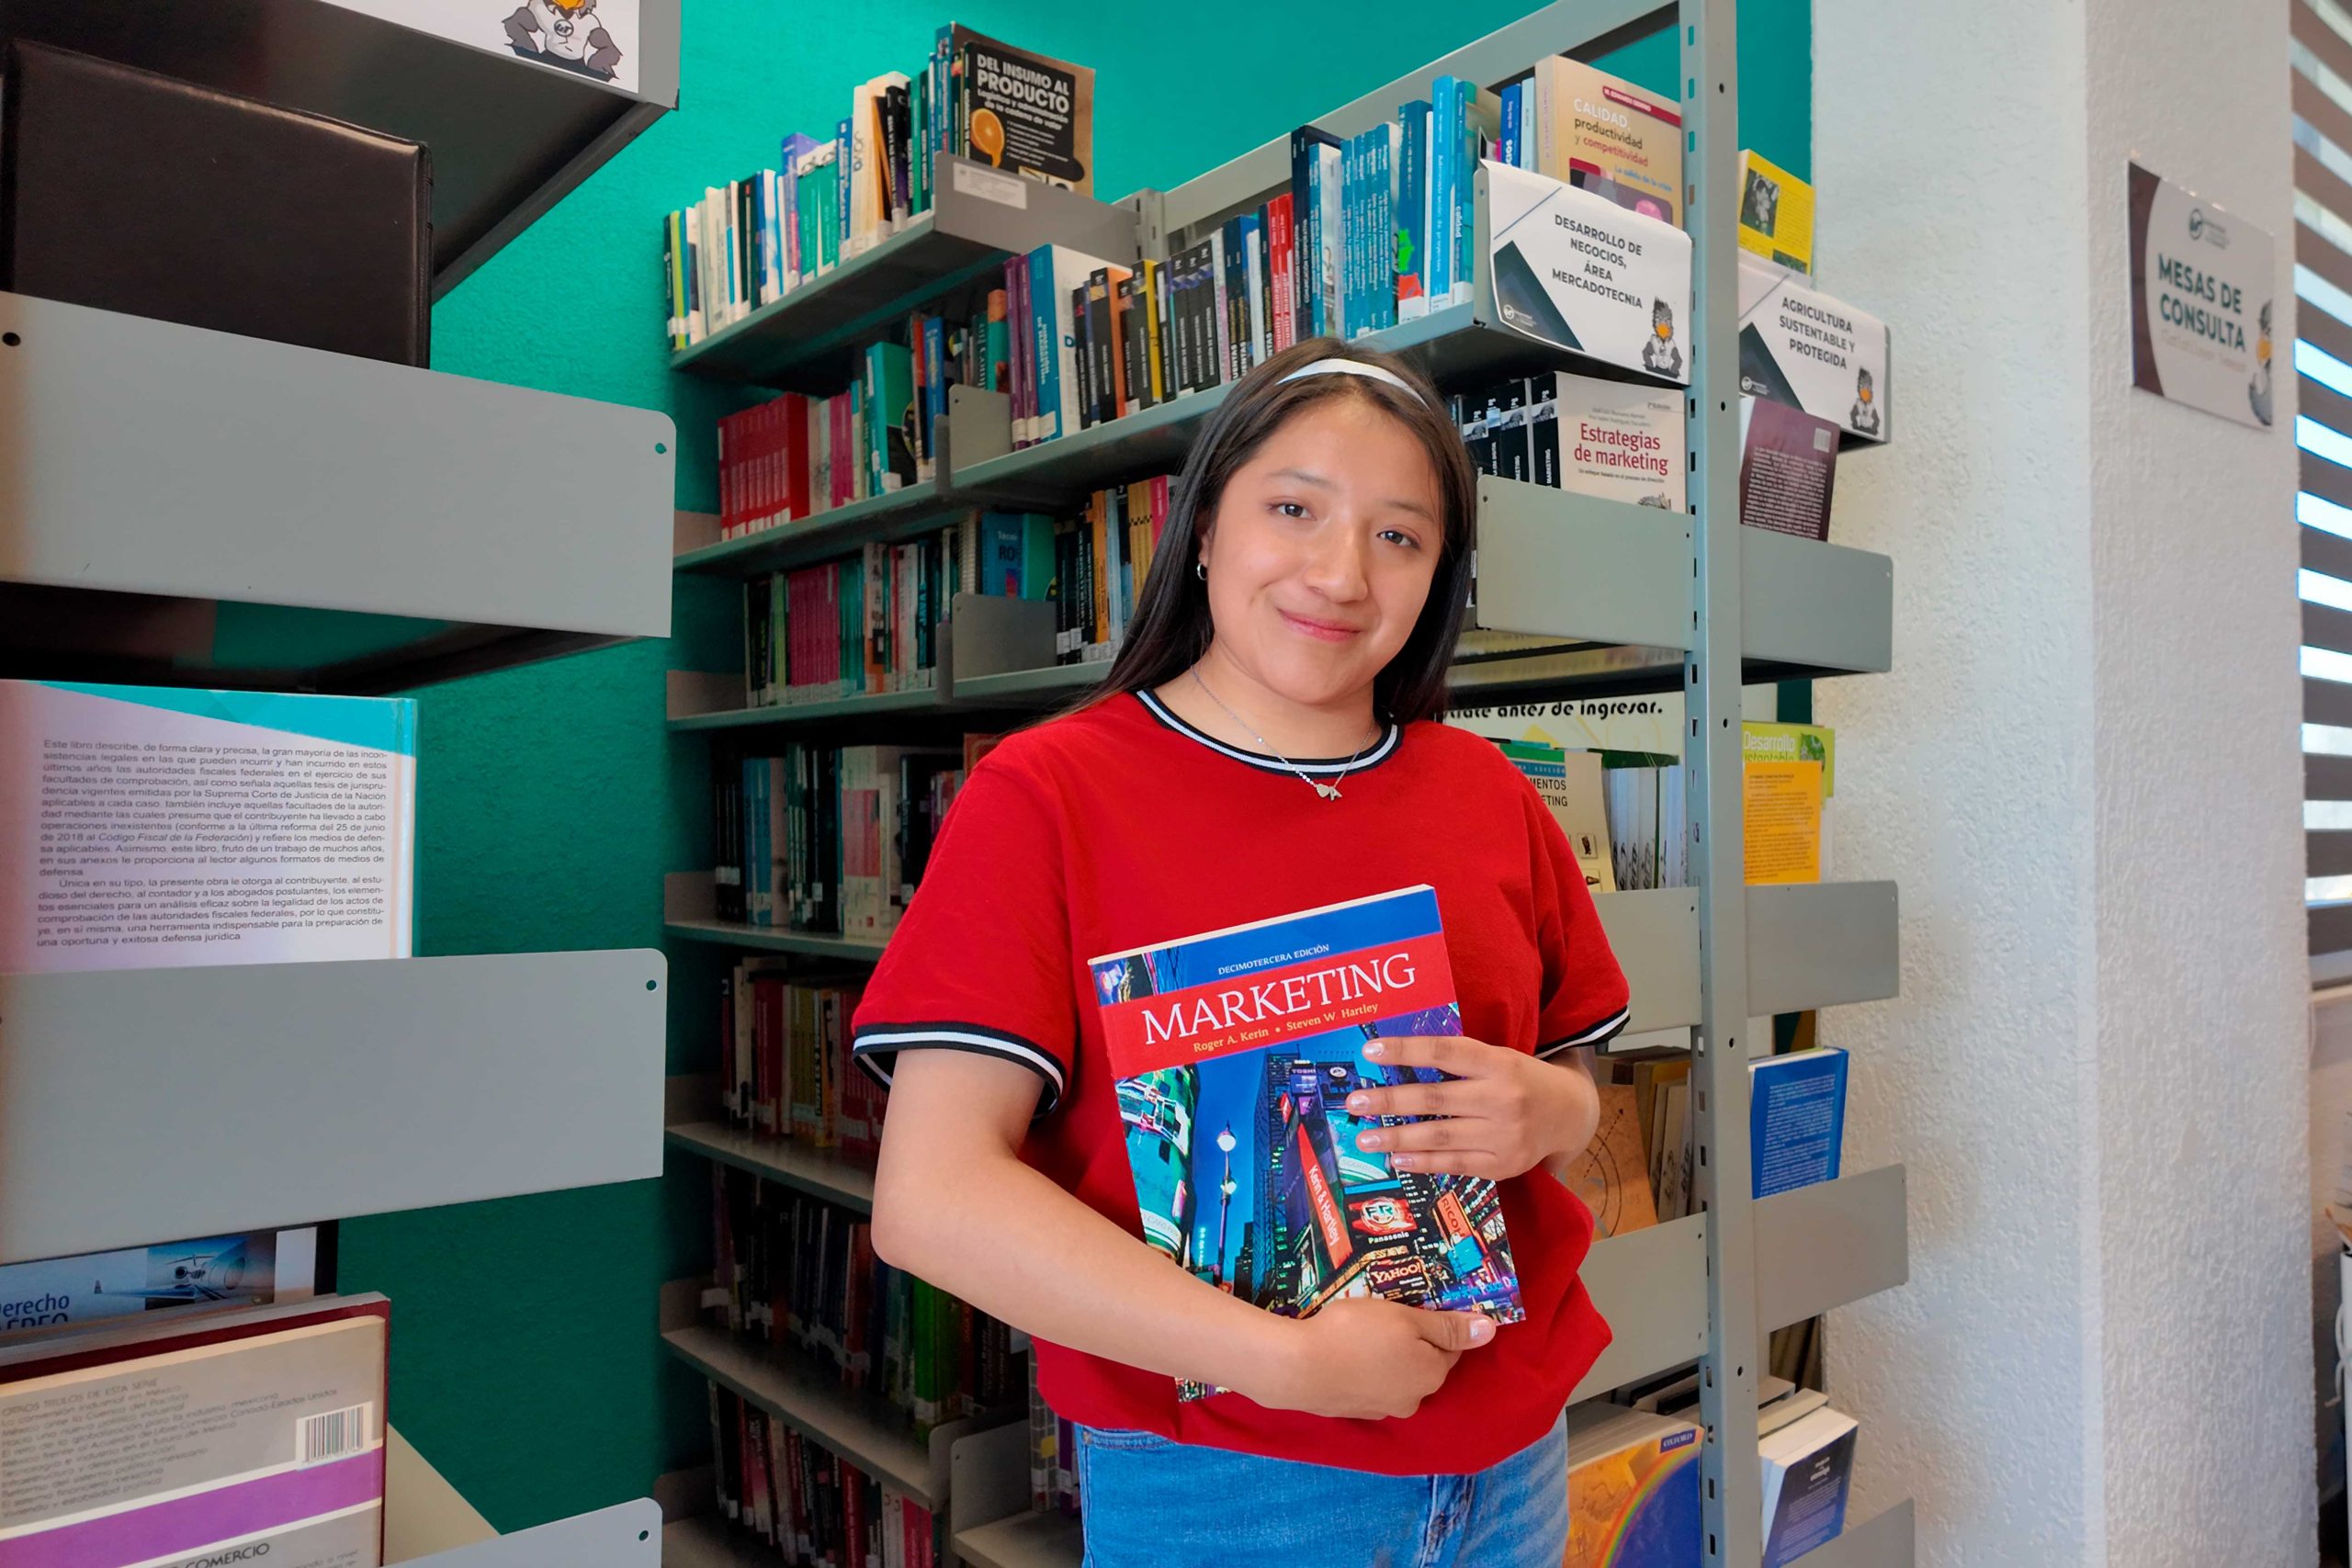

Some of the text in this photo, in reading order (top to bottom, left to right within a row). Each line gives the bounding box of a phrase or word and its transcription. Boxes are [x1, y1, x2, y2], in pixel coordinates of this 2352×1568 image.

[978, 53, 1069, 96] DEL INSUMO AL
[978, 69, 1069, 114] PRODUCTO
[1573, 98, 1632, 130] CALIDAD,
[1575, 118, 1643, 149] productividad
[1575, 135, 1648, 167] y competitividad
[1555, 214, 1643, 255] DESARROLLO DE
[1571, 238, 1626, 269] NEGOCIOS,
[1584, 260, 1613, 281] ÁREA
[2159, 254, 2242, 314] MESAS DE
[1553, 268, 1643, 309] MERCADOTECNIA
[1782, 298, 1852, 333] AGRICULTURA
[2160, 294, 2245, 353] CONSULTA
[1779, 316, 1855, 353] SUSTENTABLE Y
[1790, 338, 1847, 369] PROTEGIDA
[1580, 423, 1660, 452] Estrategias
[1575, 443, 1668, 476] de marketing
[1498, 705, 1546, 718] antes
[1551, 702, 1574, 716] de
[1580, 700, 1663, 720] ingresar.
[43, 739, 67, 749] Este
[70, 740, 92, 749] libro
[142, 742, 156, 751] de
[158, 743, 187, 752] forma
[188, 744, 212, 752] clara
[214, 747, 220, 755] y
[261, 746, 270, 754] la
[271, 749, 293, 757] gran
[333, 749, 345, 757] de
[345, 749, 358, 757] las
[1743, 731, 1795, 752] Desarrollo
[43, 751, 96, 761] sistencias
[100, 752, 138, 763] legales
[158, 754, 173, 762] las
[176, 756, 196, 765] que
[199, 755, 236, 766] pueden
[240, 757, 273, 765] incurrir
[276, 759, 281, 767] y
[285, 758, 302, 766] han
[306, 759, 345, 767] incurrido
[363, 760, 387, 768] estos
[116, 764, 131, 773] las
[135, 765, 196, 774] autoridades
[199, 766, 236, 775] fiscales
[240, 768, 284, 776] federales
[302, 769, 311, 777] el
[314, 770, 353, 780] ejercicio
[41, 774, 97, 784] facultades
[99, 775, 113, 784] de
[273, 779, 312, 790] aquellas
[313, 780, 335, 788] tesis
[61, 936, 108, 948] oportuna
[112, 938, 118, 946] y
[120, 934, 158, 944] exitosa
[161, 933, 201, 942] defensa
[1218, 942, 1329, 976] DECIMOTERCERA EDICIÓN
[1142, 953, 1417, 1045] MARKETING
[1193, 1040, 1224, 1053] Roger
[1227, 1036, 1238, 1045] A.
[1240, 1029, 1270, 1042] Kerin
[1286, 1018, 1321, 1031] Steven
[1341, 1003, 1378, 1020] Hartley
[1309, 1165, 1340, 1247] Kerin & Hartley
[1368, 1231, 1409, 1244] Panasonic
[1371, 1262, 1421, 1284] YAHOO!
[0, 1293, 70, 1317] erecho
